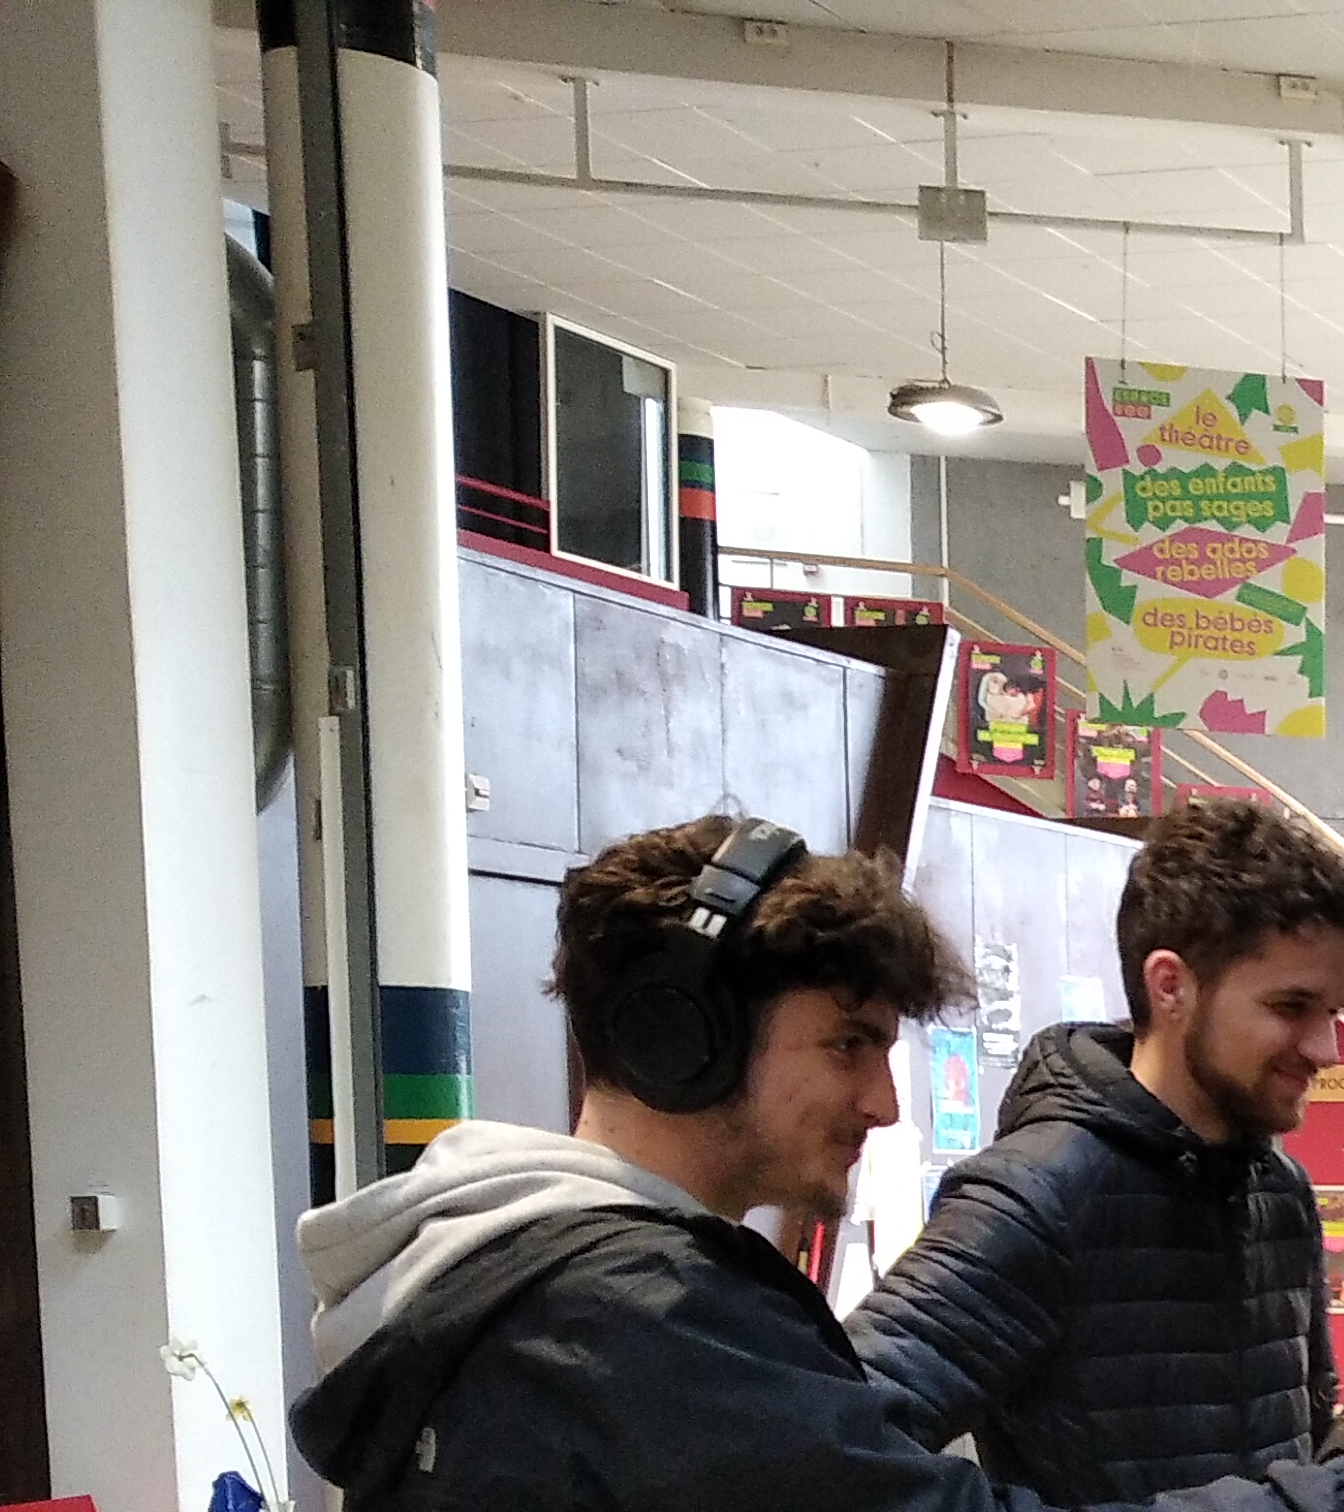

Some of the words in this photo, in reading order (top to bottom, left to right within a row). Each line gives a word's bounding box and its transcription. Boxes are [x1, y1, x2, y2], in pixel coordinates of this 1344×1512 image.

[1194, 406, 1218, 428] le
[1160, 422, 1251, 455] théâtre
[1135, 475, 1180, 499] des
[1188, 473, 1276, 495] enfants
[1147, 497, 1194, 519] pas
[1200, 497, 1274, 522] sages
[1152, 540, 1199, 560] des
[1207, 540, 1270, 562] ados
[1156, 559, 1257, 582] rebelles
[1141, 607, 1188, 629] des
[1194, 609, 1274, 634] bébés
[1170, 628, 1257, 656] pirates
